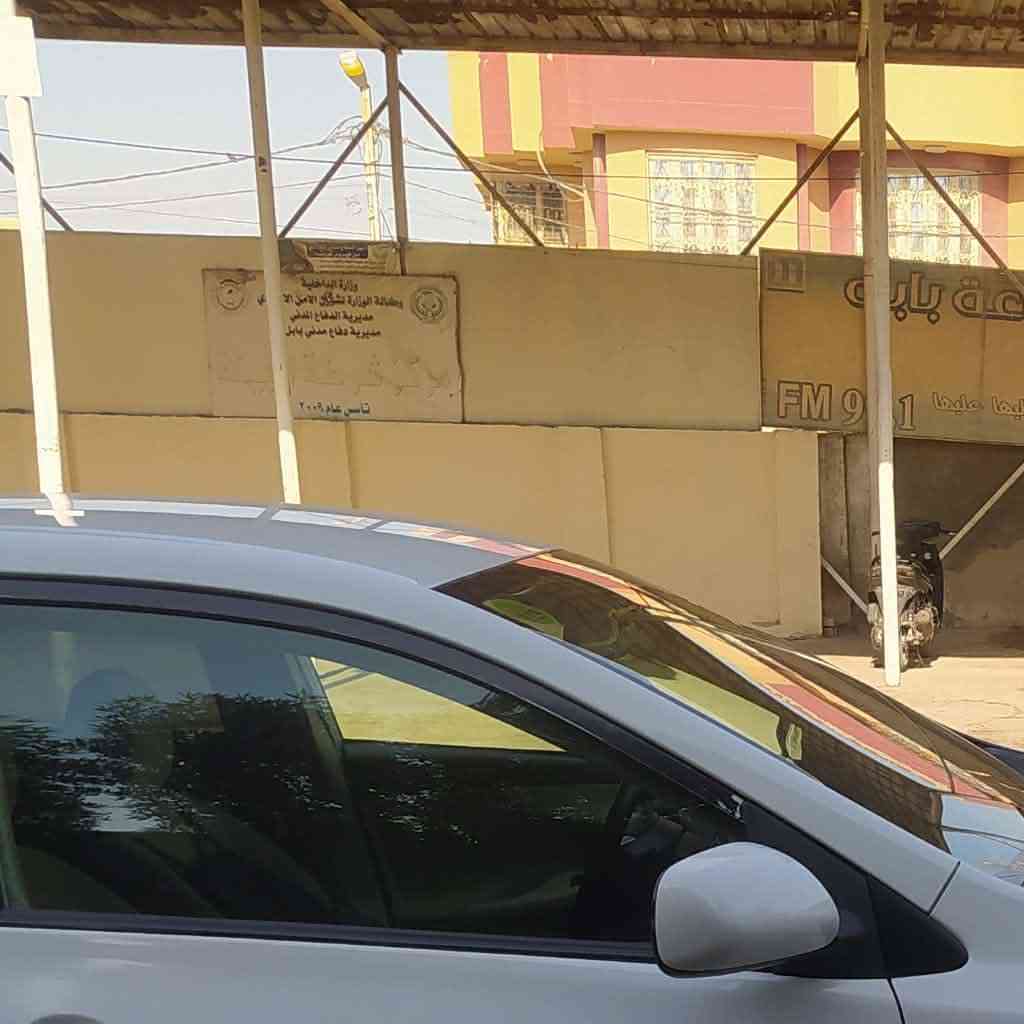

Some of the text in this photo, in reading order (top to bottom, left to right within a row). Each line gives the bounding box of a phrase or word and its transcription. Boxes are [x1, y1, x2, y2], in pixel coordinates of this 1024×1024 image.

[301, 278, 359, 292] وزارة الداخلية
[348, 294, 373, 308] الوزارة
[289, 310, 374, 325] مديرية الدفاع المدني
[304, 326, 327, 339] مدني
[328, 326, 349, 339] دفاع
[350, 326, 382, 340] مديرية
[776, 380, 833, 422] FM
